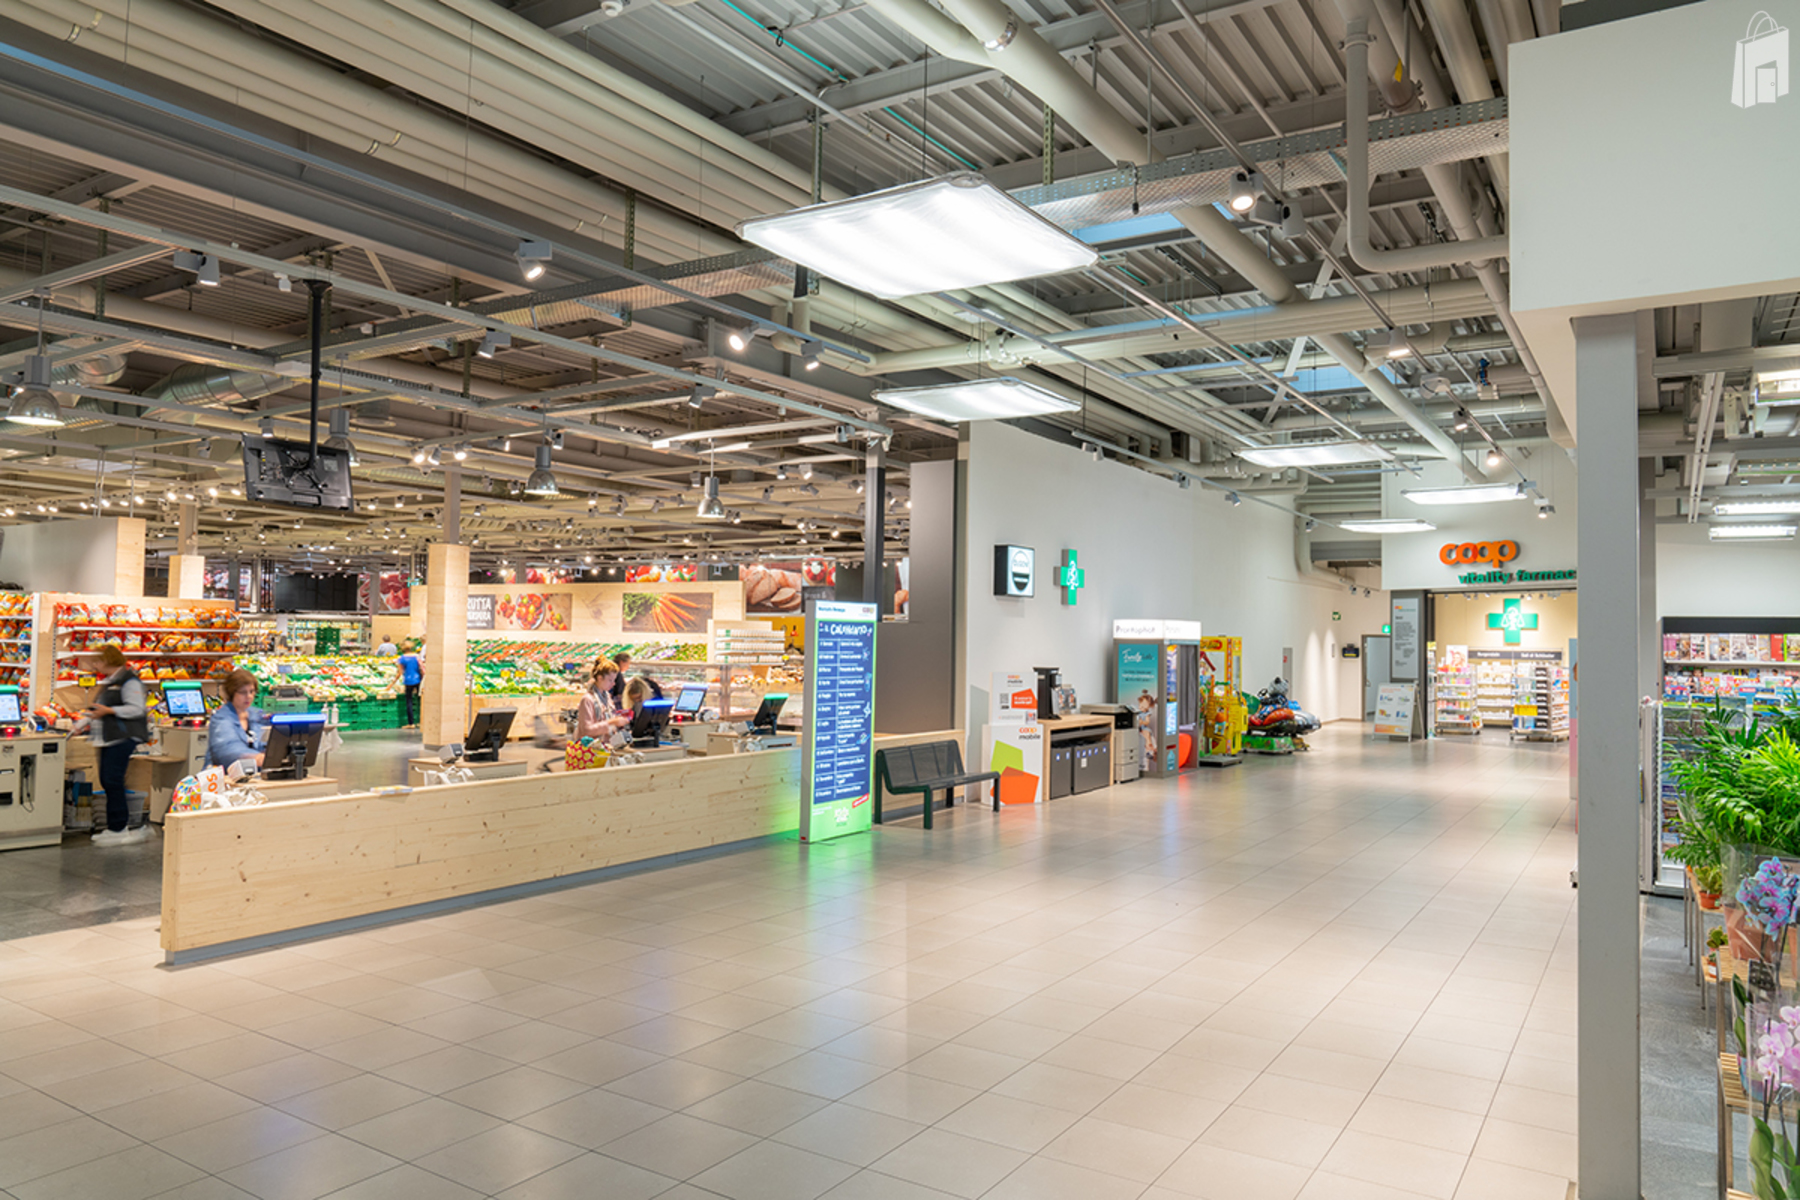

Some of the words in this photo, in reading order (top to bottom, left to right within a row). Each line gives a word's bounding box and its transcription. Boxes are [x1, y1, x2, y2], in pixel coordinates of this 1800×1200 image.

[1439, 539, 1517, 568] coop
[1458, 570, 1511, 584] vitality
[1516, 569, 1575, 582] farmac
[467, 597, 492, 610] RUTTA
